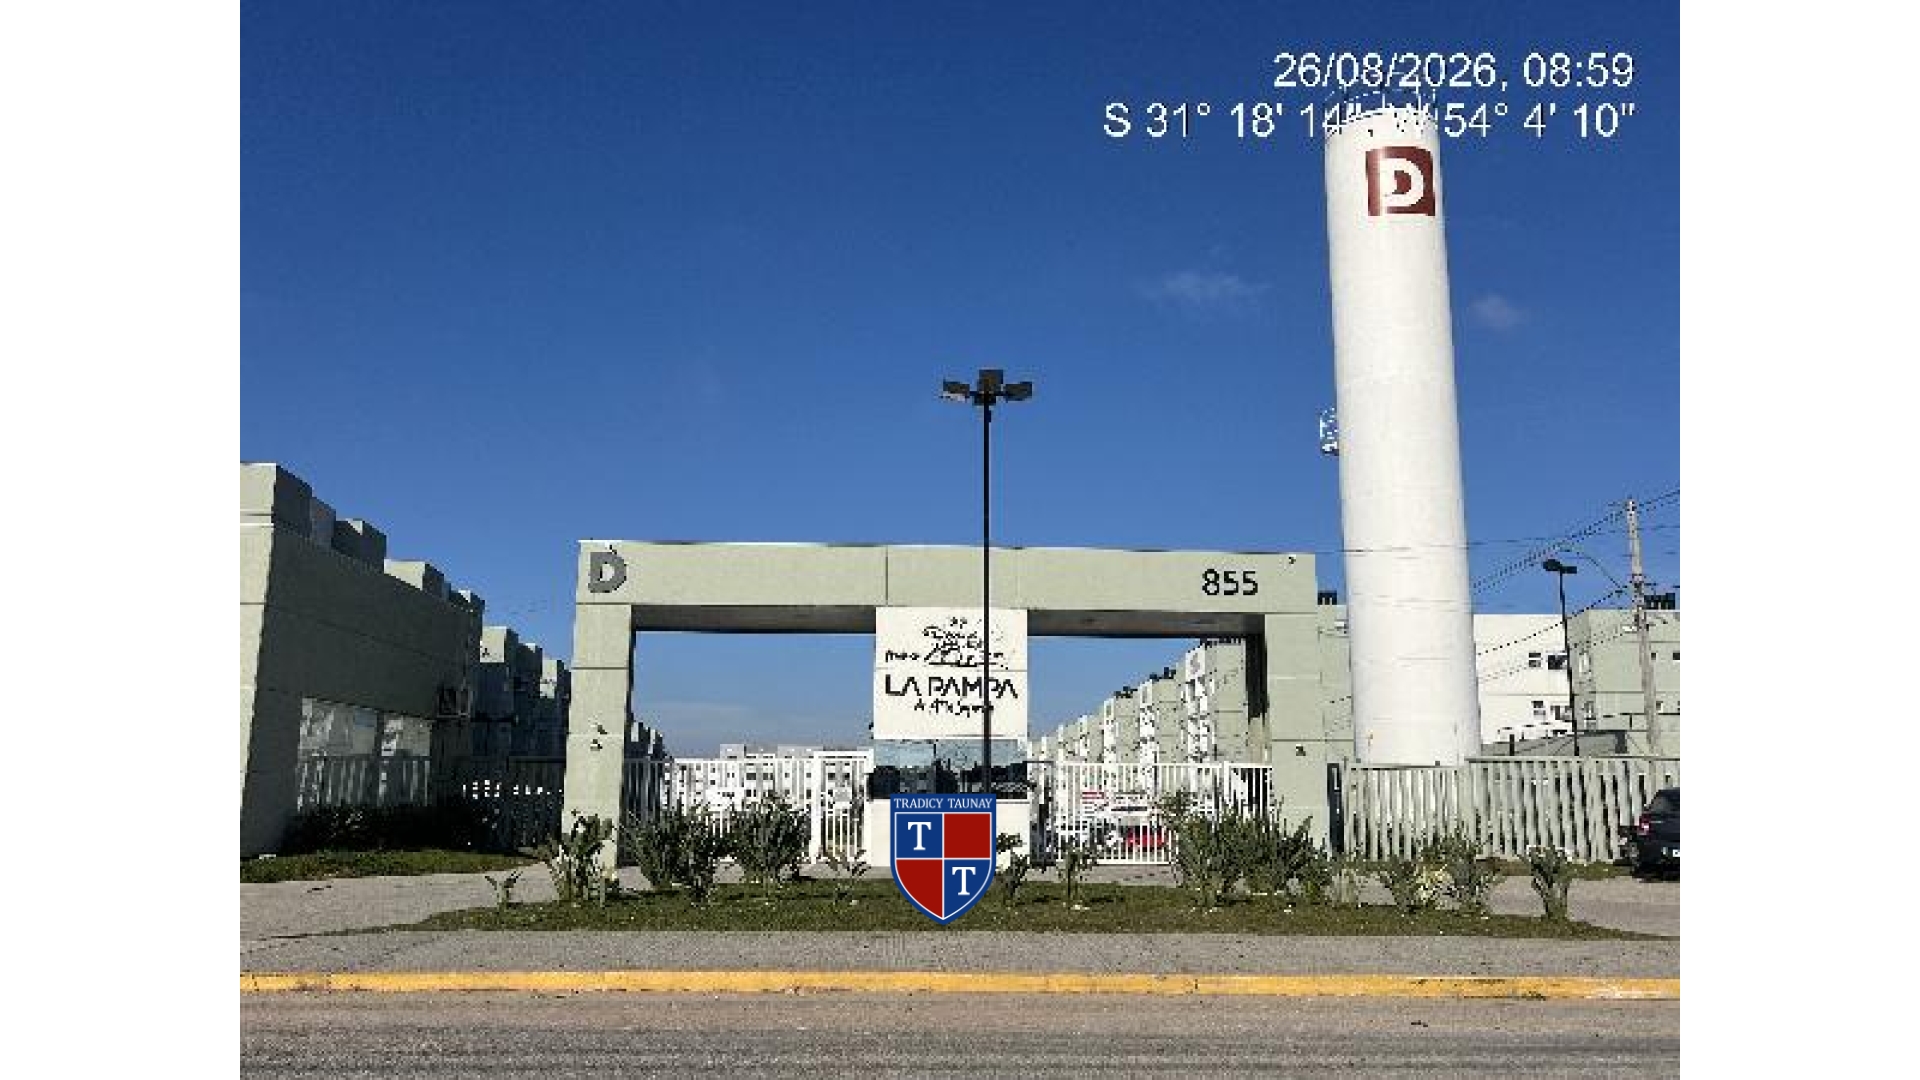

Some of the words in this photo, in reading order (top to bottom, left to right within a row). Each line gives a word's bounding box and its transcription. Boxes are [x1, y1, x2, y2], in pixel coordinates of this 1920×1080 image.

[588, 551, 627, 594] D
[1202, 568, 1258, 596] 855
[885, 674, 922, 696] LA
